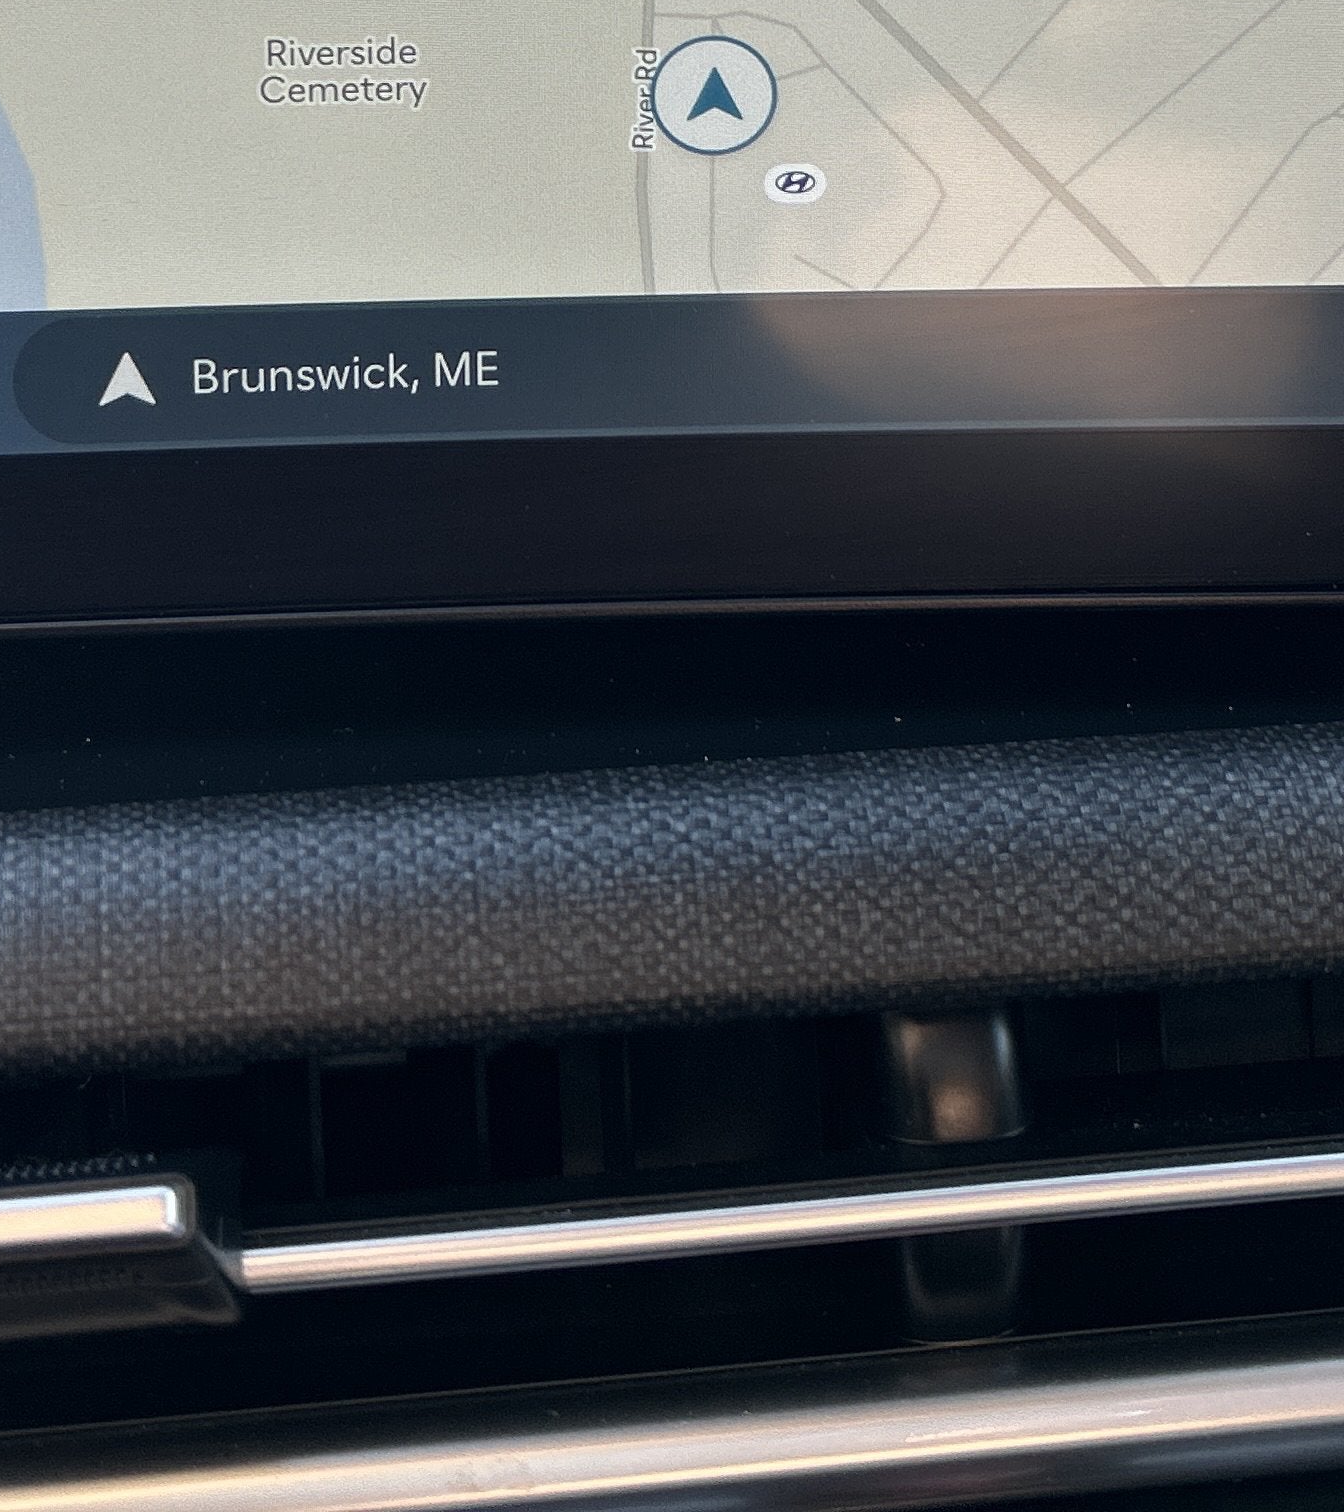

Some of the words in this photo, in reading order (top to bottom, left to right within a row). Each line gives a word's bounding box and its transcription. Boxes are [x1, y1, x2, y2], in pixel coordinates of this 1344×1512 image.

[265, 36, 418, 67] Riverside
[635, 48, 658, 79] Rd
[258, 75, 428, 108] Cemetery
[632, 85, 655, 150] River
[192, 353, 419, 395] Brunswick,
[433, 350, 500, 388] ME
